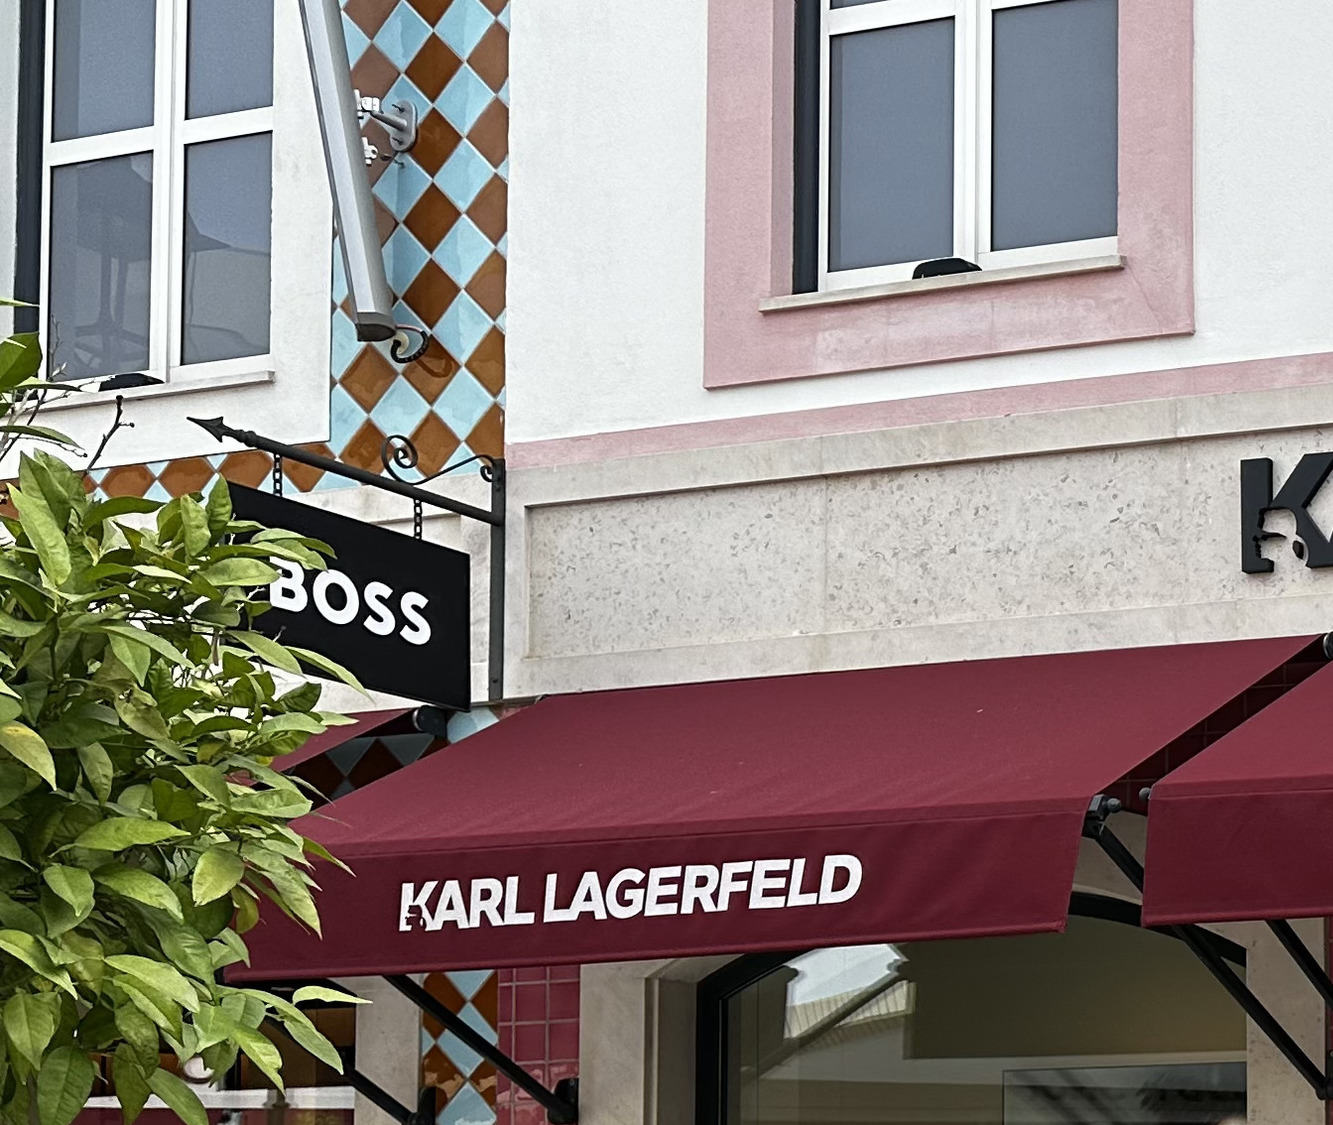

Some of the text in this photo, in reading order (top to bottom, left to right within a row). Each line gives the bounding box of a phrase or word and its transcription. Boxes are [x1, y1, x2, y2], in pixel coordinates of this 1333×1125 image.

[269, 556, 432, 645] BOSS
[399, 854, 863, 931] KARL LAGERFELD
